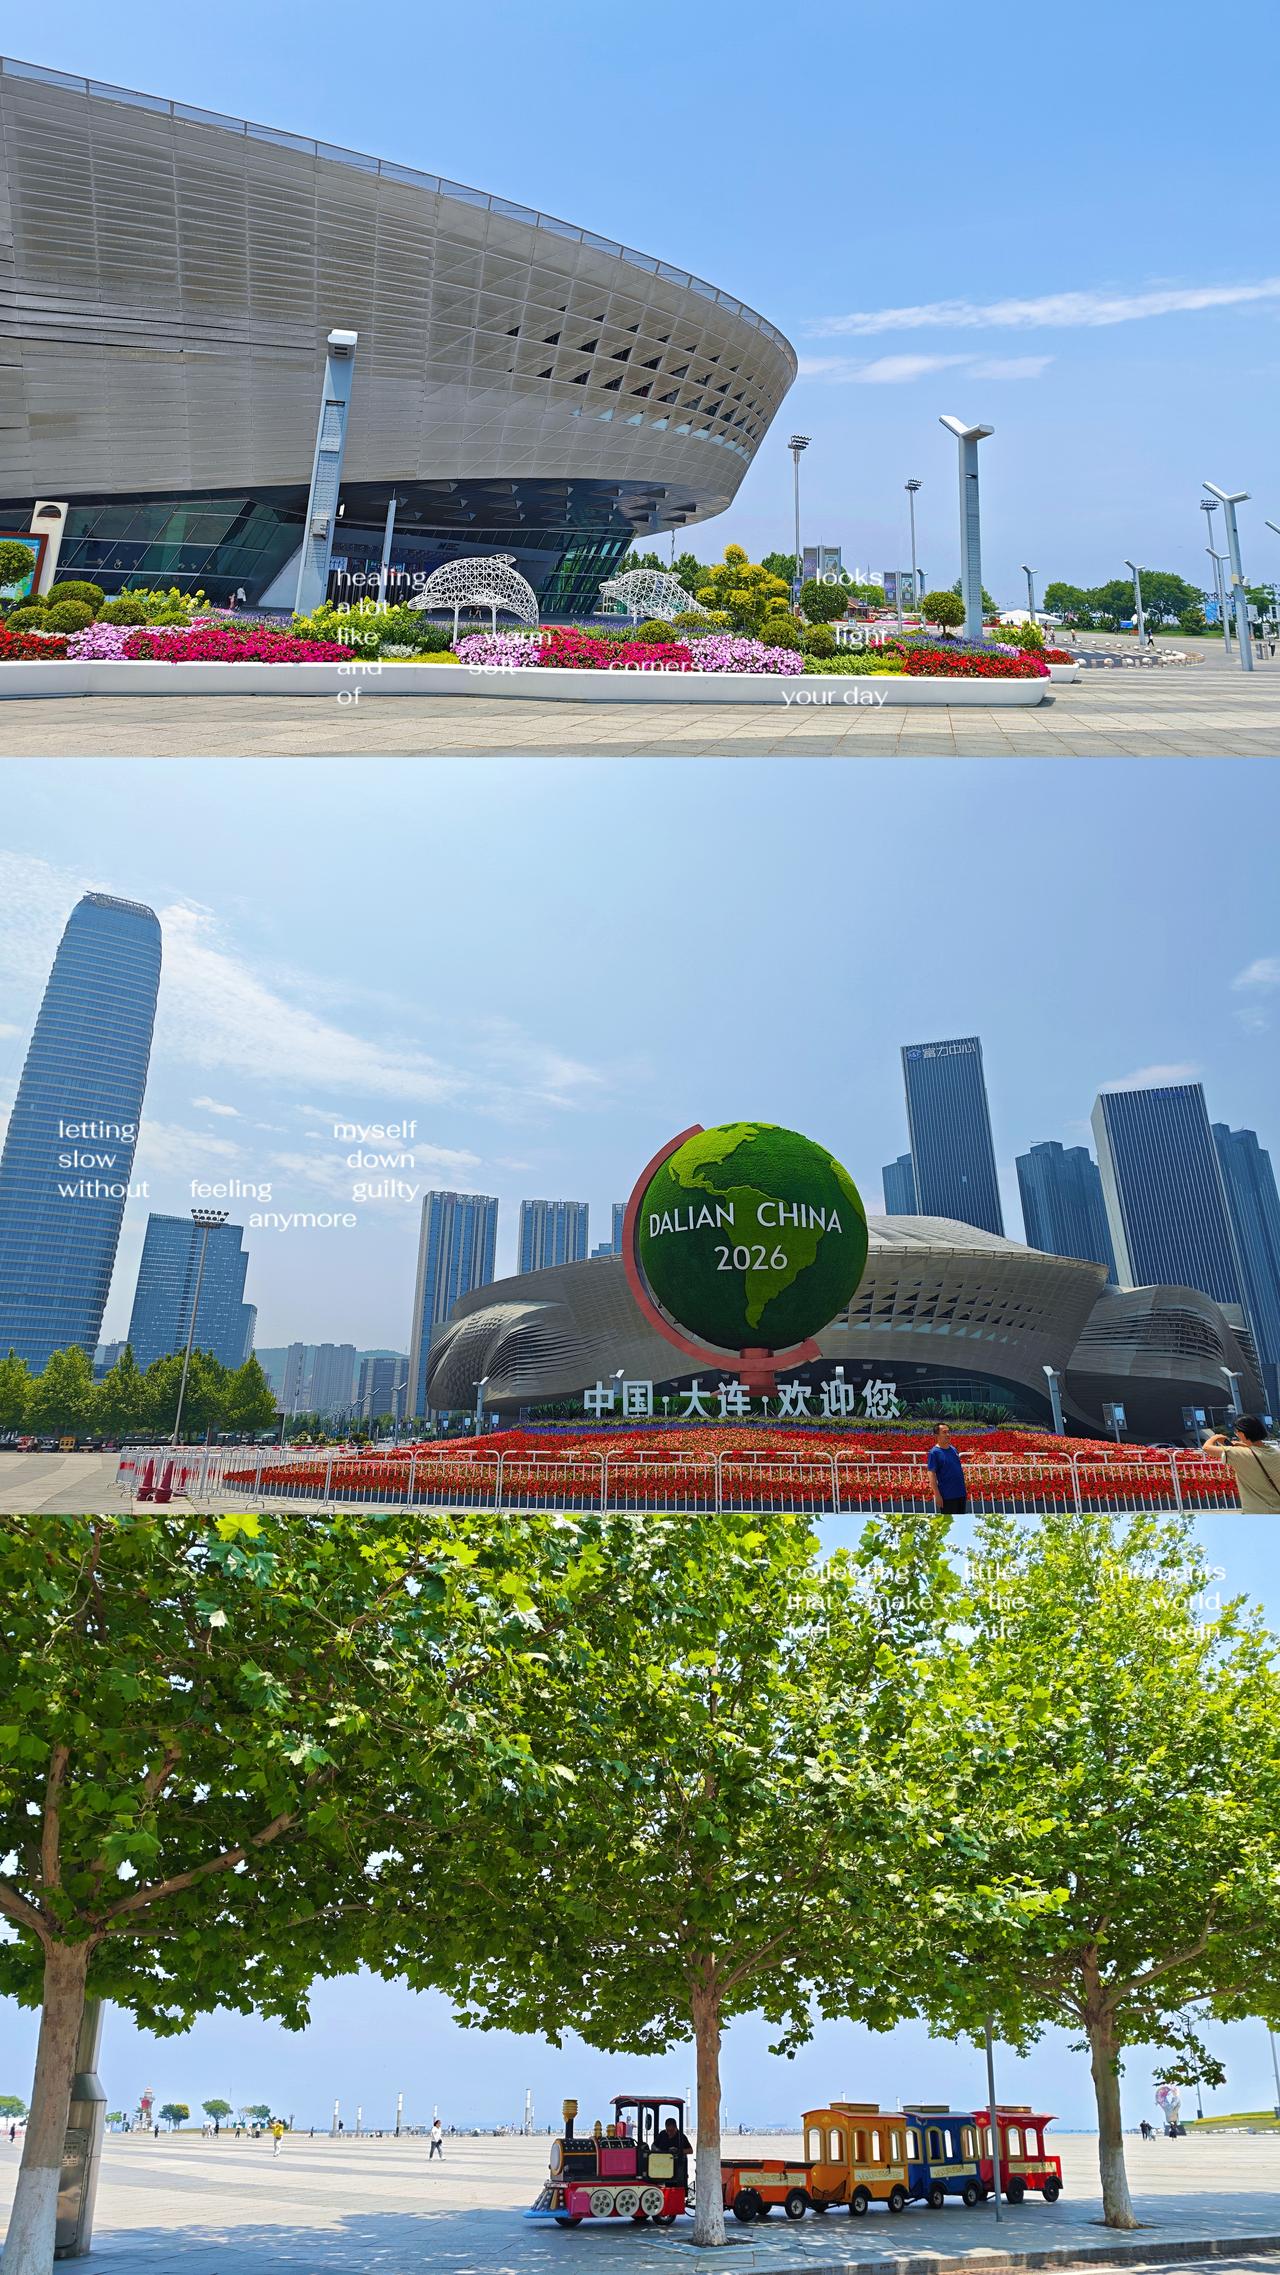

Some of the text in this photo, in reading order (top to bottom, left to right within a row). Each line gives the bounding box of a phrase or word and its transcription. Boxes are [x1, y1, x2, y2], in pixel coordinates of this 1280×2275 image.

[650, 1202, 843, 1238] DALIAN CHINA
[713, 1244, 789, 1271] 2026
